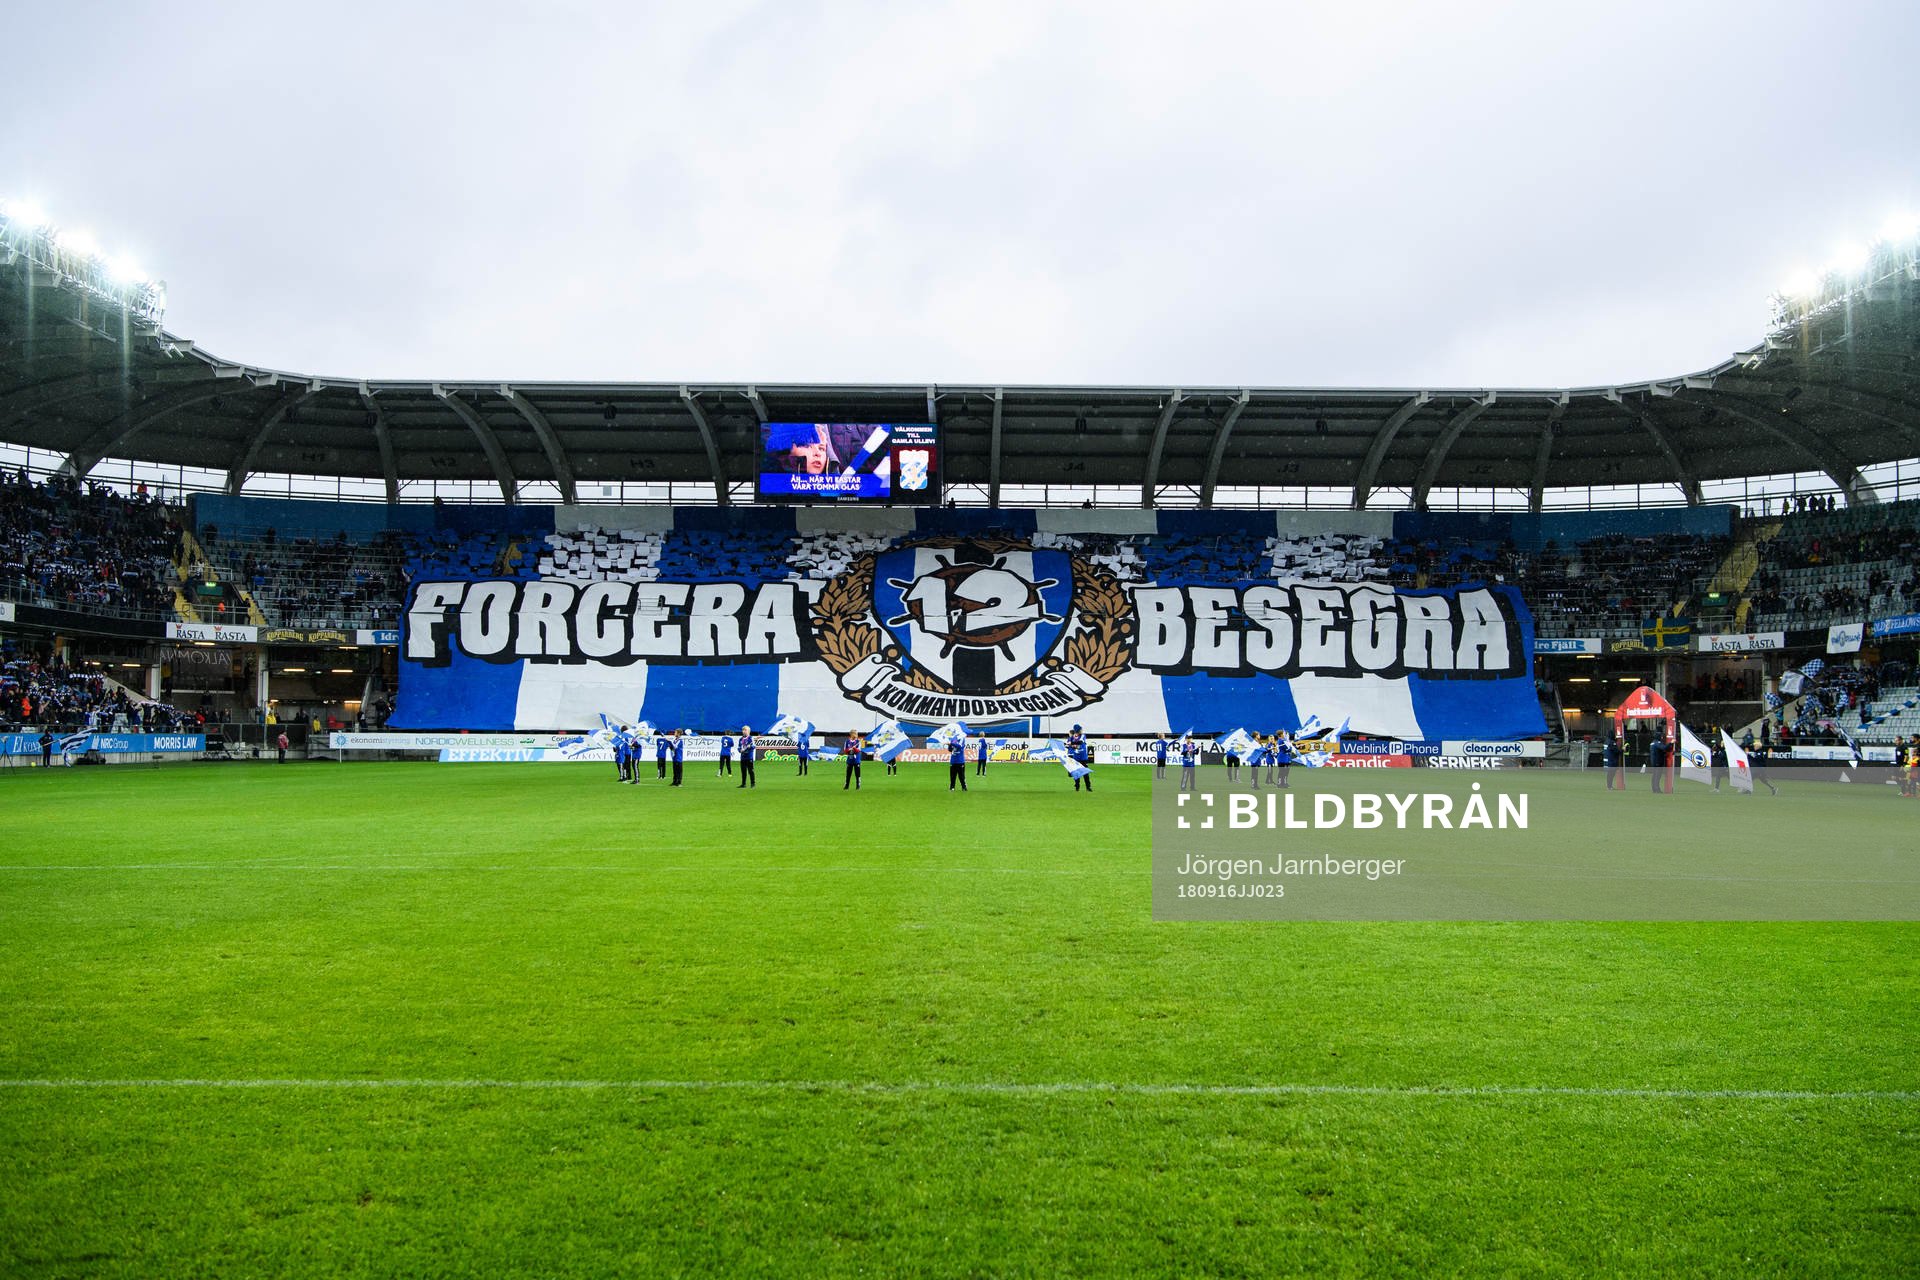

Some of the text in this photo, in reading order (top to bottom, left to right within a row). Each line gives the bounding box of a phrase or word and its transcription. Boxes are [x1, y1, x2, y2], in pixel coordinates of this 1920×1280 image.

[906, 567, 1040, 634] 12
[407, 580, 801, 659] FORCERA
[1133, 584, 1510, 670] BESEGRA
[176, 629, 247, 641] RASTA RASTA
[381, 632, 399, 641] Idr
[1551, 640, 1577, 651] Fjäll
[1711, 639, 1775, 651] RASTA RASTA
[874, 683, 1073, 717] KOMMANDOBRYGGAN
[154, 737, 197, 749] MORRIS LAW
[723, 739, 728, 748] 5
[1343, 743, 1387, 754] Weblink
[1404, 743, 1439, 754] Phone
[447, 749, 532, 761] EFFEKTIV
[1465, 744, 1521, 755] clean park
[1327, 755, 1391, 768] Scandic
[1429, 756, 1502, 769] SERNEKE
